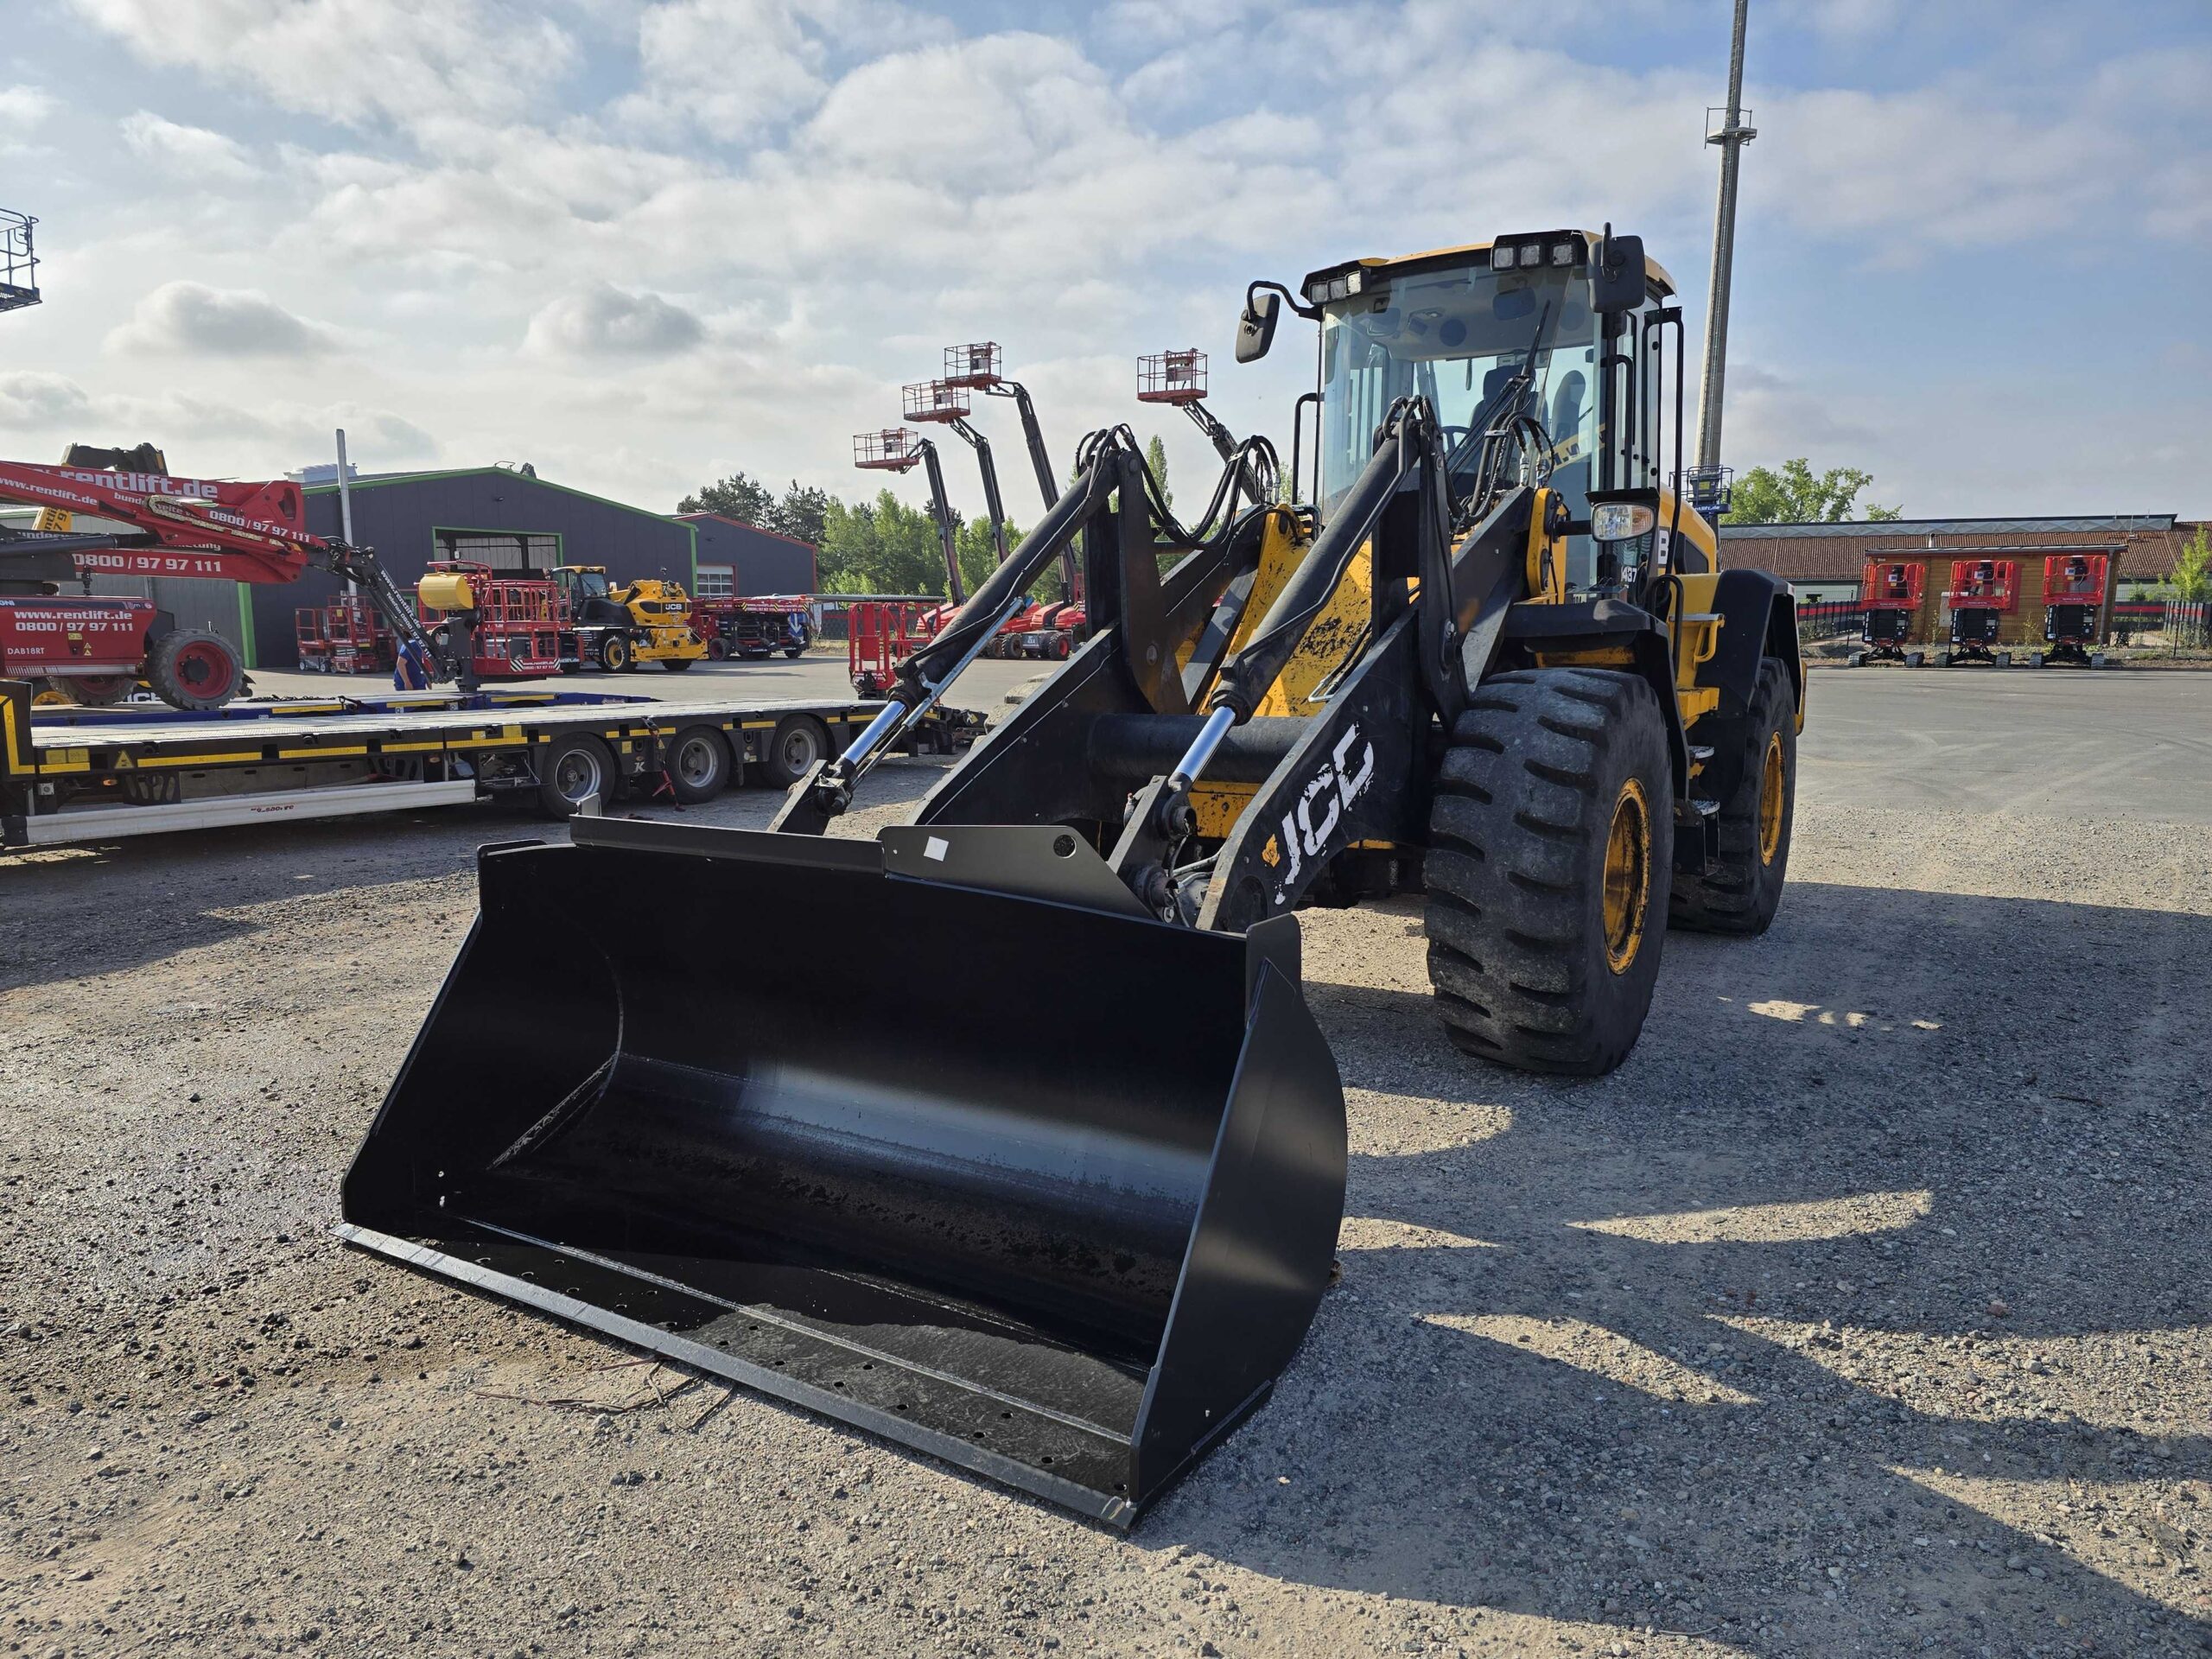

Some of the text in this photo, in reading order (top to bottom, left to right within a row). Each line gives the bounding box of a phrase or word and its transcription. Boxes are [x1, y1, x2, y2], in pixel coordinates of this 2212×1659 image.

[209, 510, 245, 526] 0800
[253, 522, 270, 533] 97
[272, 527, 288, 537] 97
[292, 531, 310, 543] 111
[72, 554, 221, 572] 0800 / 97 97 111
[380, 570, 422, 629] www.rentlift.de
[14, 611, 132, 620] www.rentlift.de
[16, 622, 133, 632] 0800 / 97 97 111
